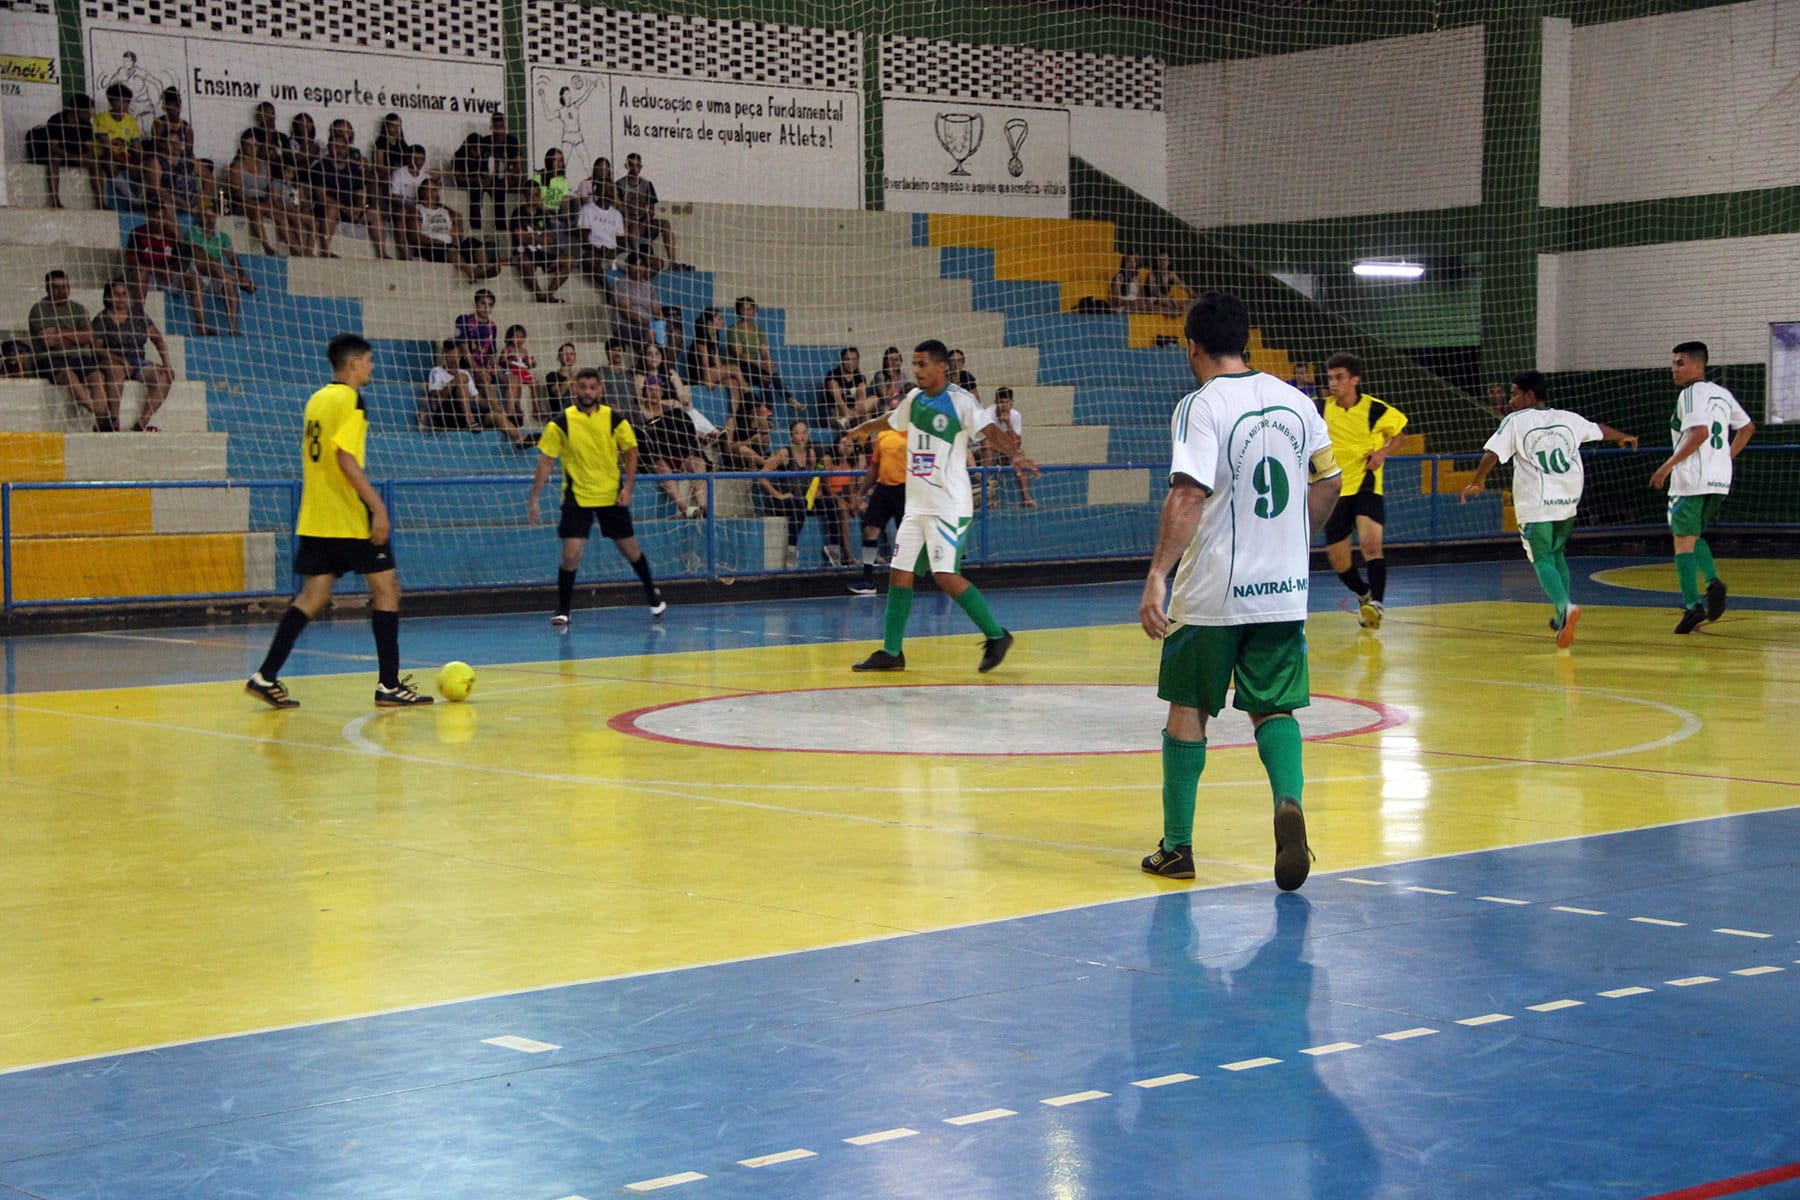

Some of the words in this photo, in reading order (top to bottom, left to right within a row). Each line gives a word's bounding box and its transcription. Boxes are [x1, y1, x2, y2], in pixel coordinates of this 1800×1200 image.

[194, 68, 261, 98] Ensinar
[271, 84, 298, 100] um
[304, 79, 373, 107] esporte
[378, 86, 386, 106] é
[391, 84, 446, 110] ensinar
[450, 96, 459, 112] a
[463, 87, 501, 114] viver
[620, 86, 628, 108] A
[632, 87, 692, 113] educação
[707, 100, 731, 114] uma
[735, 102, 763, 119] peça
[768, 96, 843, 121] Fundamental
[624, 115, 640, 137] Na
[644, 118, 693, 140] carreira
[698, 120, 713, 141] de
[718, 123, 772, 148] qualquer
[780, 123, 833, 148] Atleta!
[1710, 421, 1724, 449] 8
[1535, 448, 1571, 475] 10
[1252, 455, 1290, 519] 9
[1233, 576, 1308, 598] NAVIRAÍ-M
